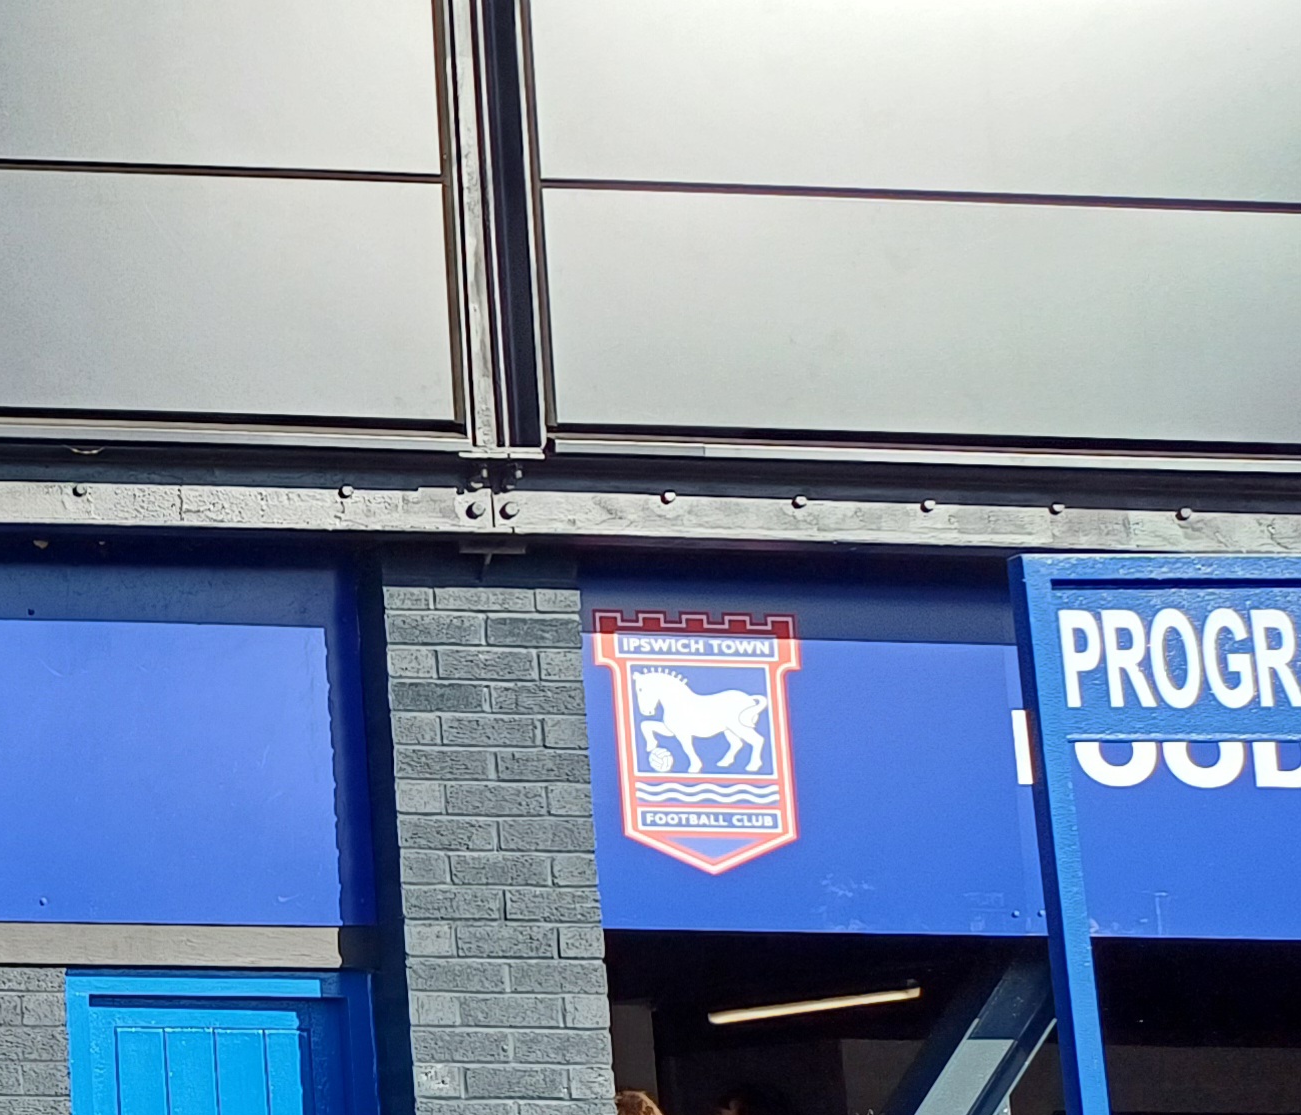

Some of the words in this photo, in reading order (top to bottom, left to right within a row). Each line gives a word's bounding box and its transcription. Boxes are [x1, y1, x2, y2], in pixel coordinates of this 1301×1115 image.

[622, 638, 704, 653] IPSWICH
[709, 640, 770, 654] TOWN
[1058, 608, 1301, 708] PROGR
[646, 812, 727, 825] FOOTBALL
[734, 814, 773, 827] CLUB
